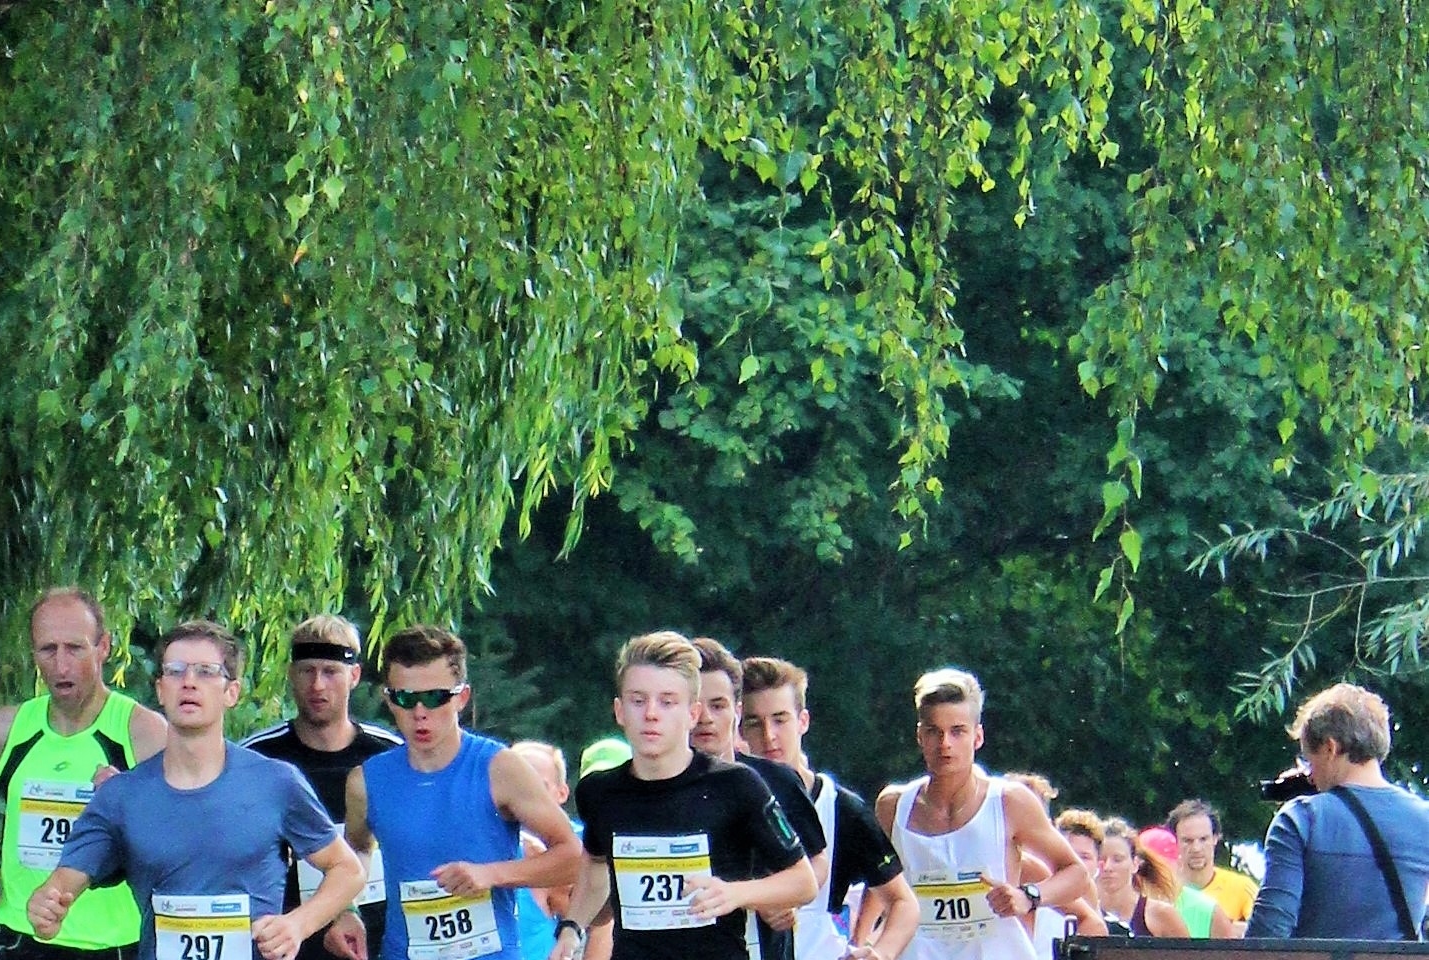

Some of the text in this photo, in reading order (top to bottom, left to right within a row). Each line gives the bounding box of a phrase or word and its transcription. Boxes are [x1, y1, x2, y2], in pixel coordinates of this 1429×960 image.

[40, 817, 71, 844] 29
[639, 874, 685, 902] 237
[934, 897, 971, 920] 210
[425, 908, 473, 941] 258
